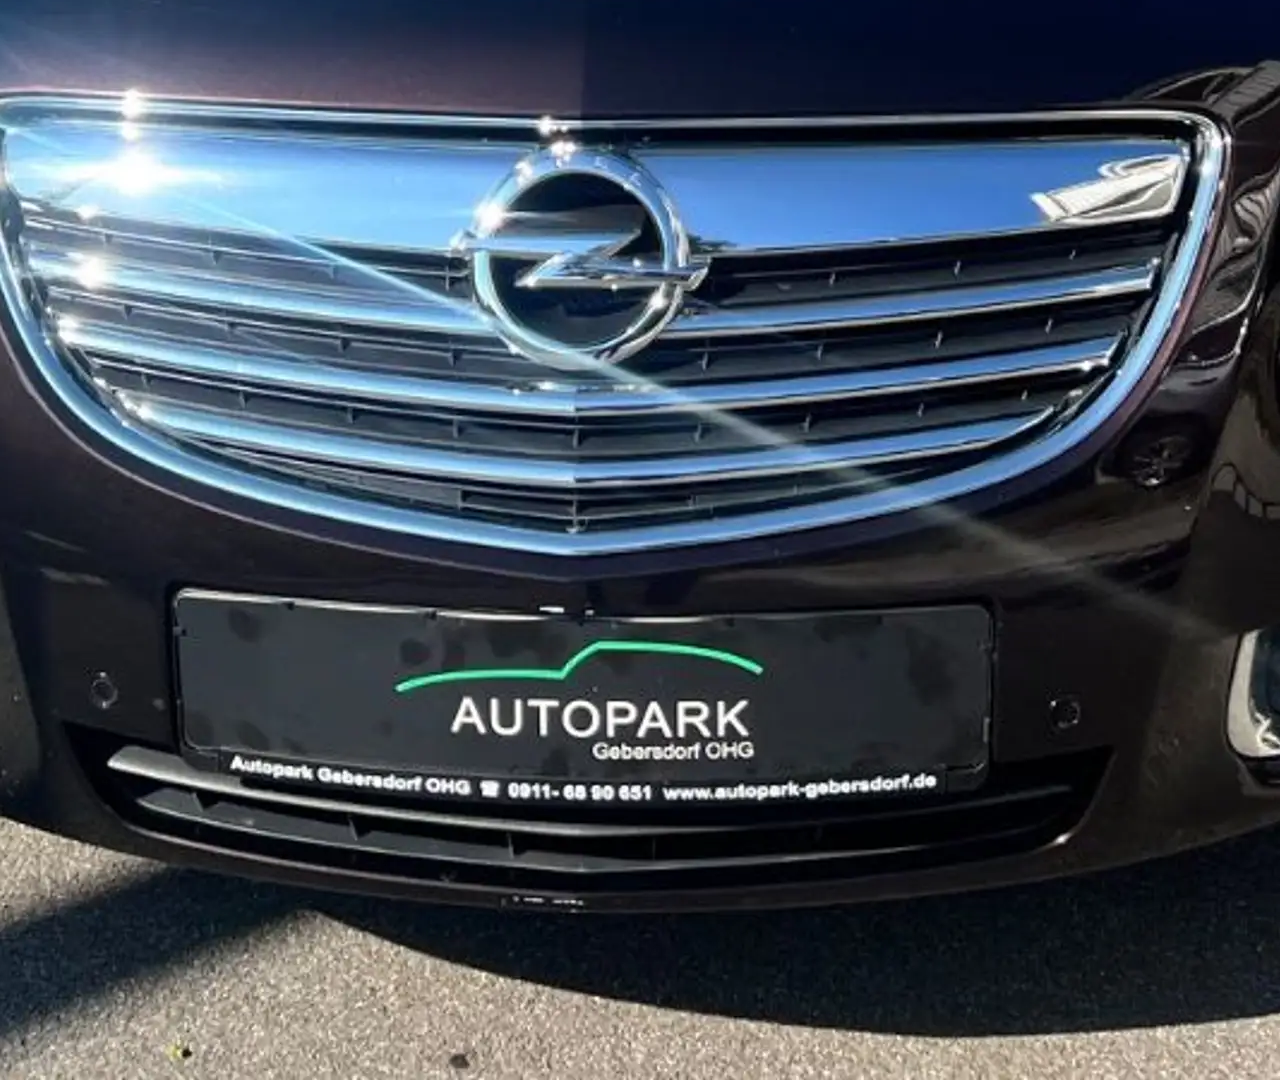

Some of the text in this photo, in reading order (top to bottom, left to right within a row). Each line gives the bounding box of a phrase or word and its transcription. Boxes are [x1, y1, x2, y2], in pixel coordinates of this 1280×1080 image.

[450, 696, 750, 739] AUTOPARK
[592, 741, 755, 761] Gebersdorf OHG
[229, 754, 315, 782] Autopark
[317, 767, 423, 793] Gebersdorf
[425, 778, 471, 797] OHG
[662, 773, 938, 802] www.autopark-gebersdorf.de
